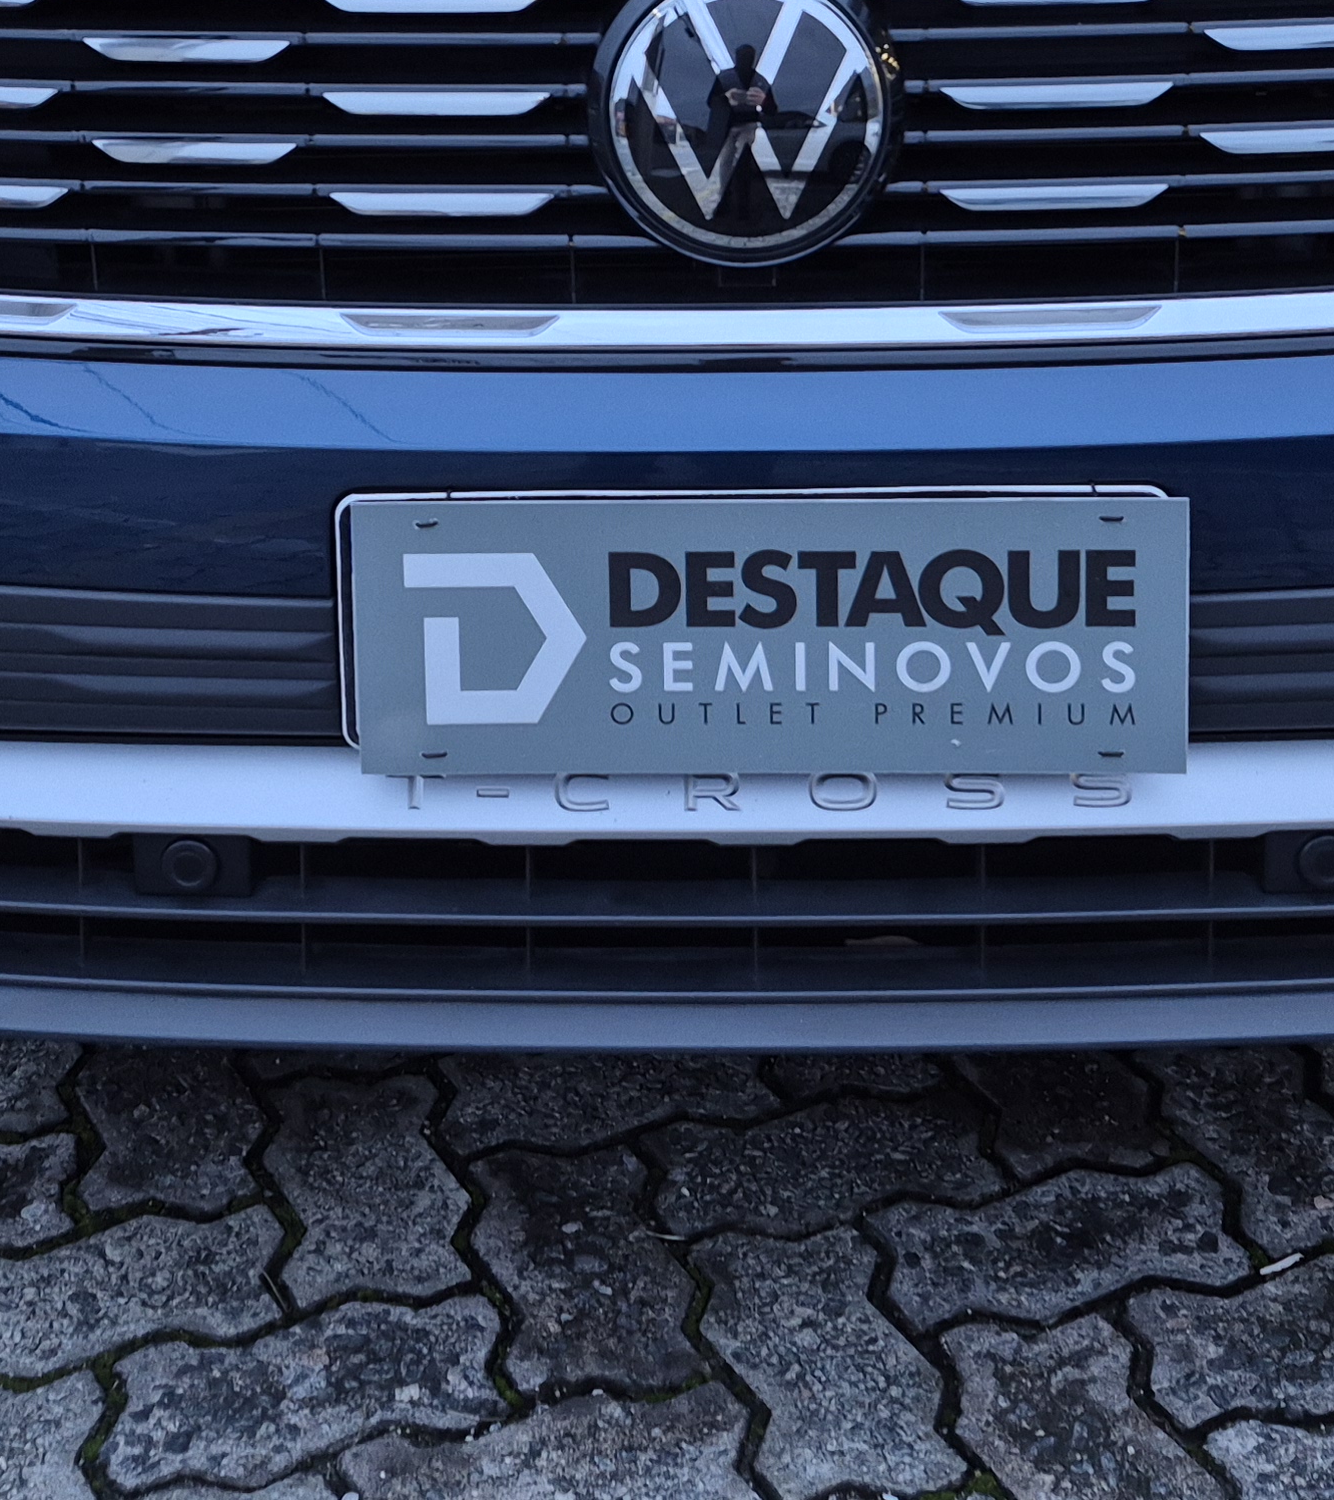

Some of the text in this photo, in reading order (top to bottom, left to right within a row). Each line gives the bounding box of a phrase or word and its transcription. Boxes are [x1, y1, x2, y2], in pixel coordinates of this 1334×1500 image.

[608, 548, 1137, 636] DESTAQUE
[610, 641, 1136, 694] SEMINOVOS
[611, 702, 1137, 726] OUTLET PREMIUM
